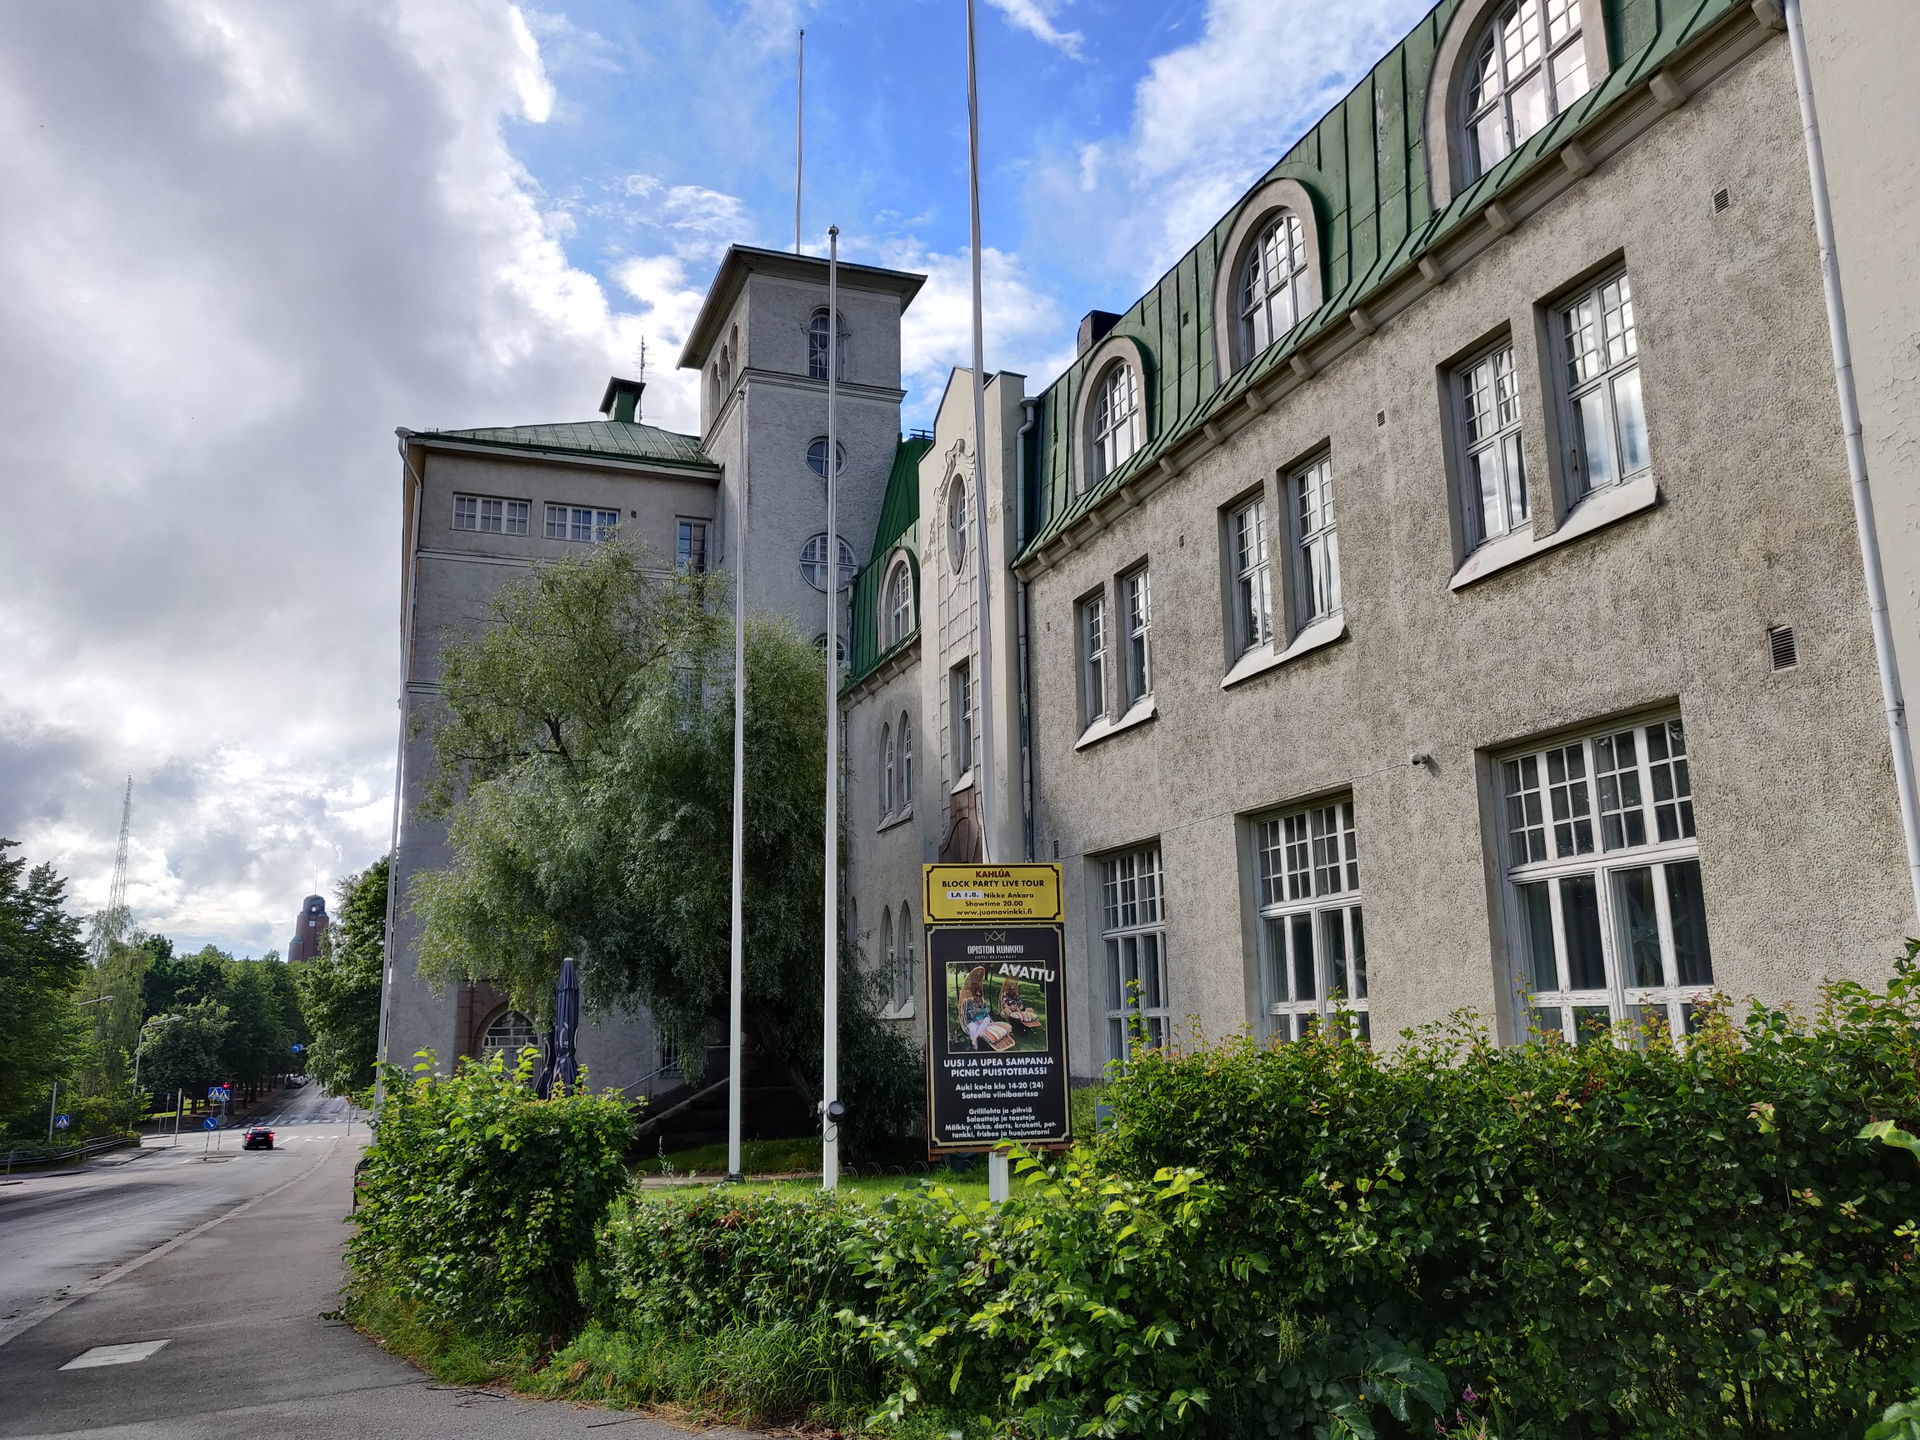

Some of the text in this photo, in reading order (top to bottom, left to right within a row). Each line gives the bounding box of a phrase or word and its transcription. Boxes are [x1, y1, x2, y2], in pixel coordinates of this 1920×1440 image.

[976, 869, 1011, 878] KAHLÚA
[956, 908, 1032, 917] www.juomavinkki.fi
[967, 945, 1023, 954] OPISTON KUNKKU
[998, 962, 1055, 982] AVATTU
[944, 1059, 964, 1067] UUSI
[1006, 1057, 1054, 1066] SAMPANJA
[951, 1067, 1047, 1077] PICNIC PUISTOTERASSI
[1029, 1081, 1044, 1089] (24)
